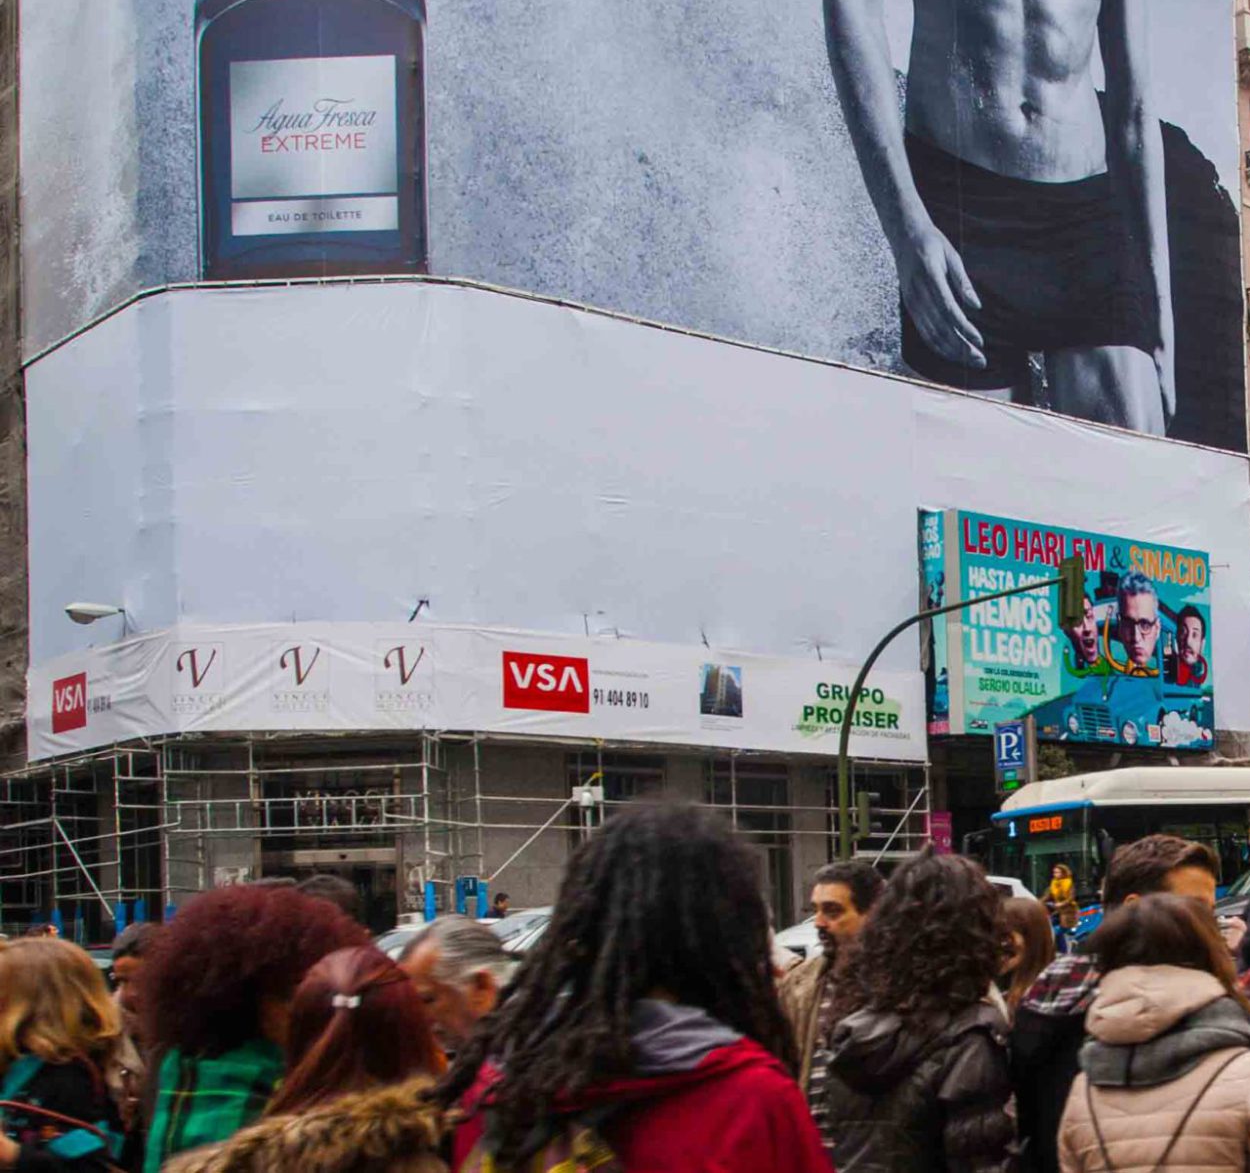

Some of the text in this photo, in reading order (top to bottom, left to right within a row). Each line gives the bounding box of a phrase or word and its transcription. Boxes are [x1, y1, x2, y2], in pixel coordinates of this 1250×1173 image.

[243, 97, 377, 136] Agua Fresca
[261, 132, 367, 153] EXTREME
[268, 210, 363, 223] EAU DE TOILETTE
[963, 517, 1008, 558] LEO
[1109, 545, 1127, 569] &
[1129, 545, 1206, 587] SINACIO
[968, 566, 1014, 595] HASTA
[968, 590, 1052, 636] HEMOS
[176, 649, 217, 688] V
[280, 645, 321, 685] V
[384, 645, 425, 685] V
[509, 661, 584, 693] VSA
[55, 683, 84, 714] VSA
[593, 688, 650, 709] 91 404 89 10
[979, 677, 1048, 696] SERGIO OLALLA
[803, 705, 900, 730] PROISER
[1000, 732, 1019, 760] P
[1008, 820, 1017, 837] 1
